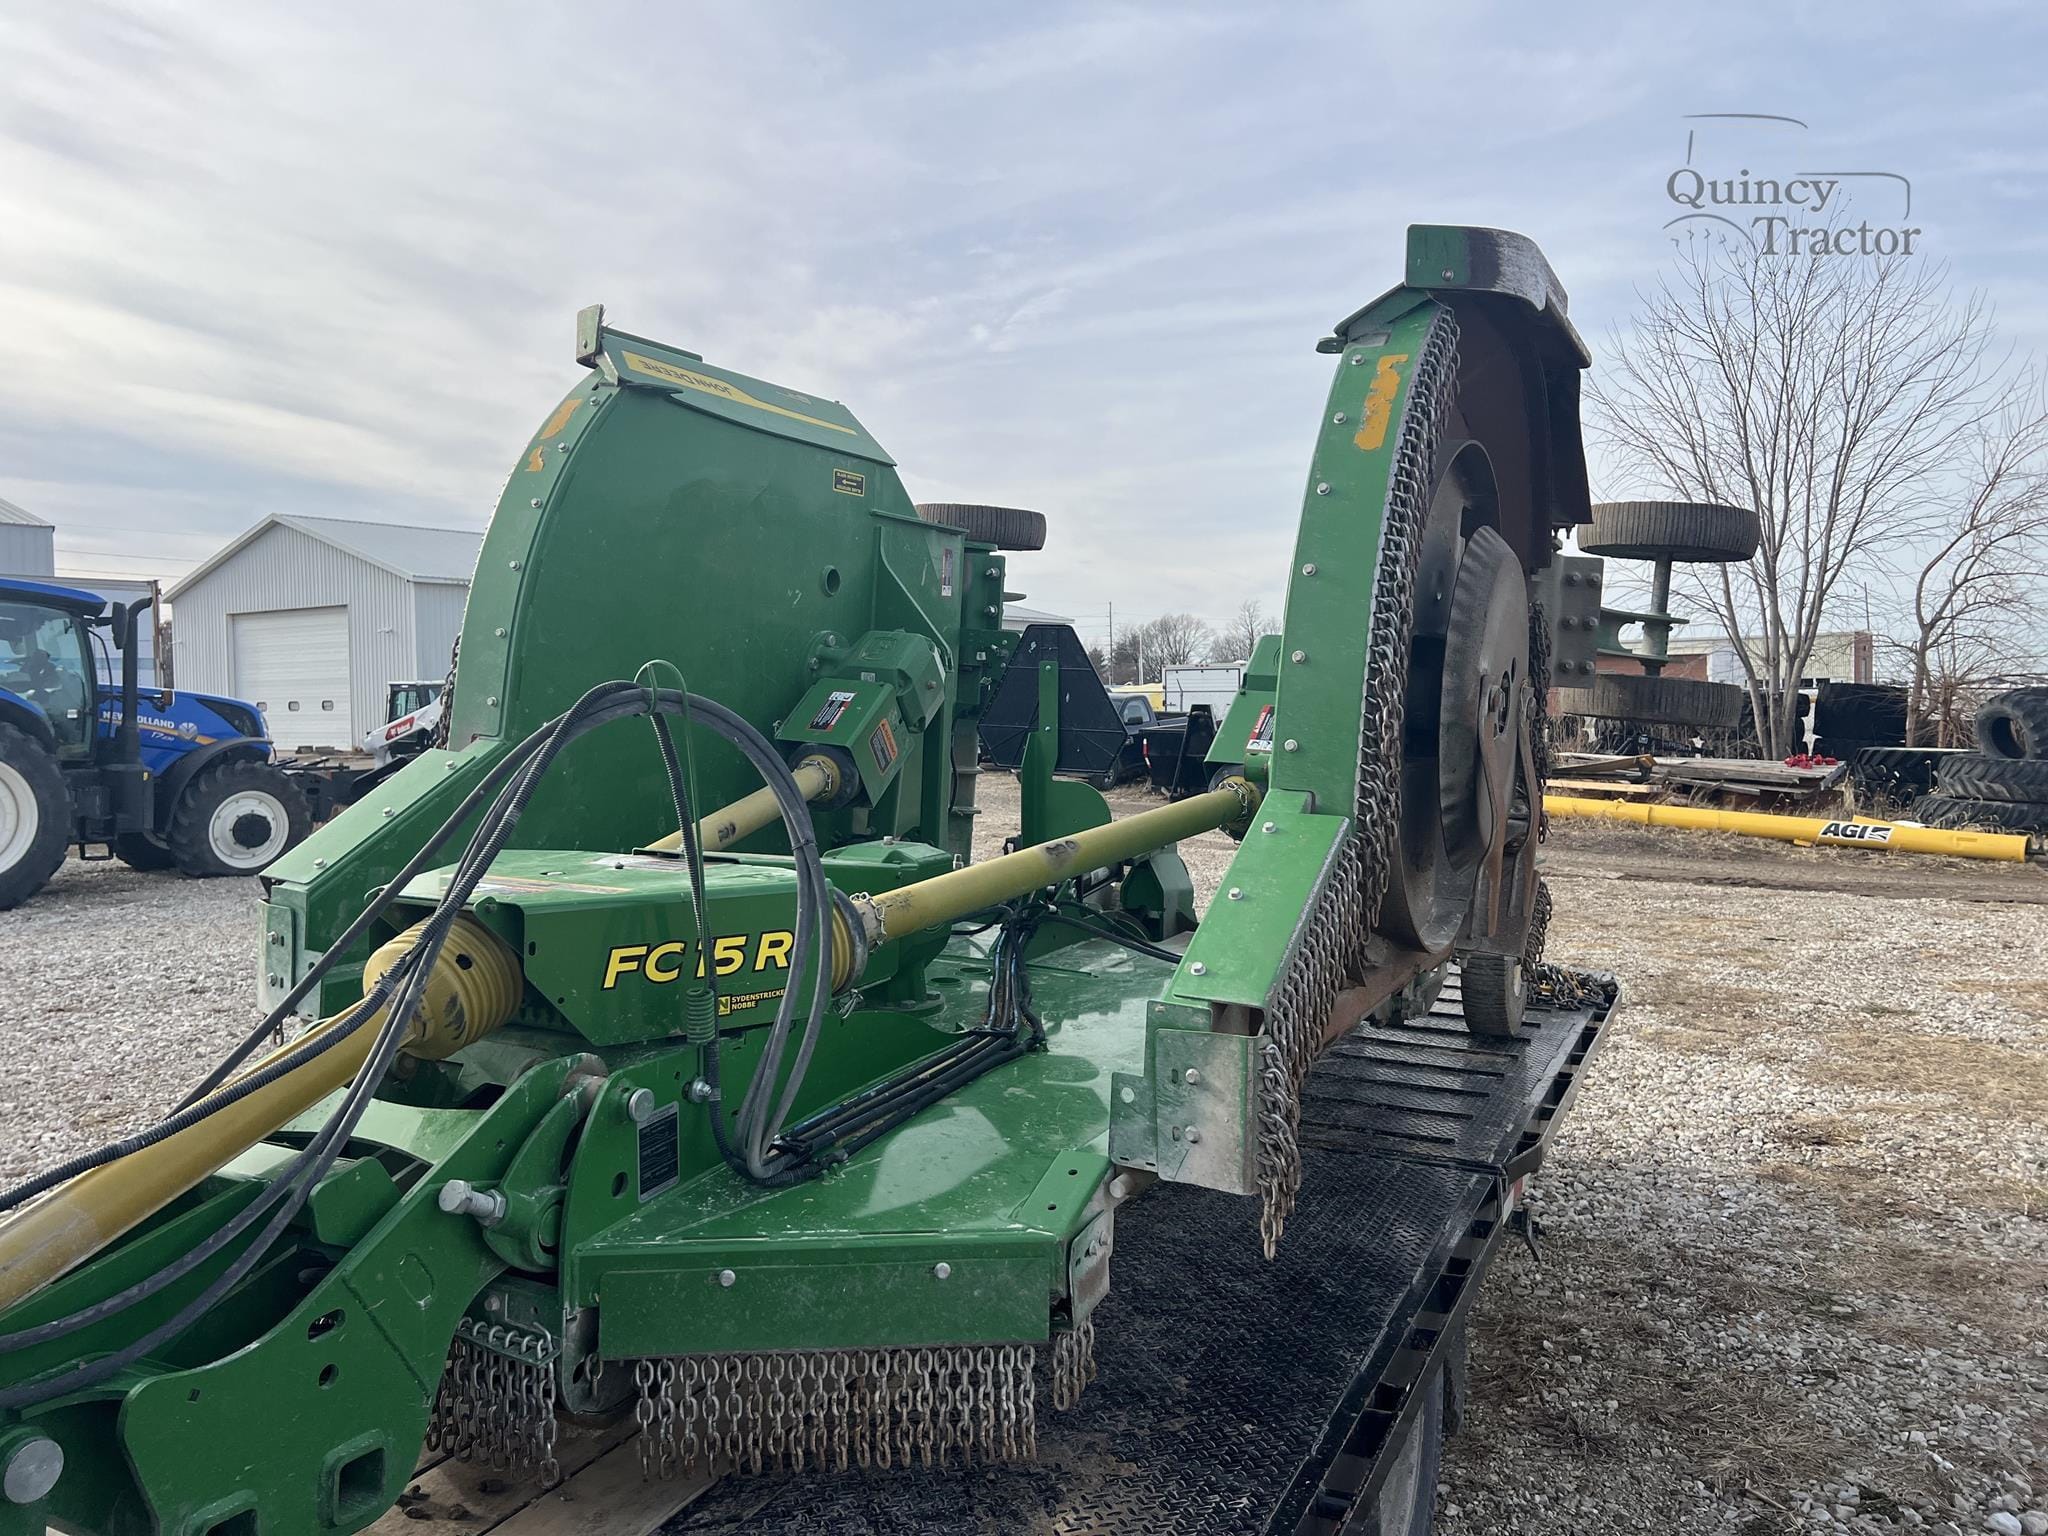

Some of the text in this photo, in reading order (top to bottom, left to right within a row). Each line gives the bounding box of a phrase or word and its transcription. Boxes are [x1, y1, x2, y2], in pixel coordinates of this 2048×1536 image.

[136, 715, 175, 729] OLLAND
[1821, 823, 1869, 839] AGI
[602, 941, 686, 990] FC
[753, 929, 795, 973] R
[731, 988, 785, 1004] SYDENSTRICKE
[731, 1000, 757, 1011] NOBBE
